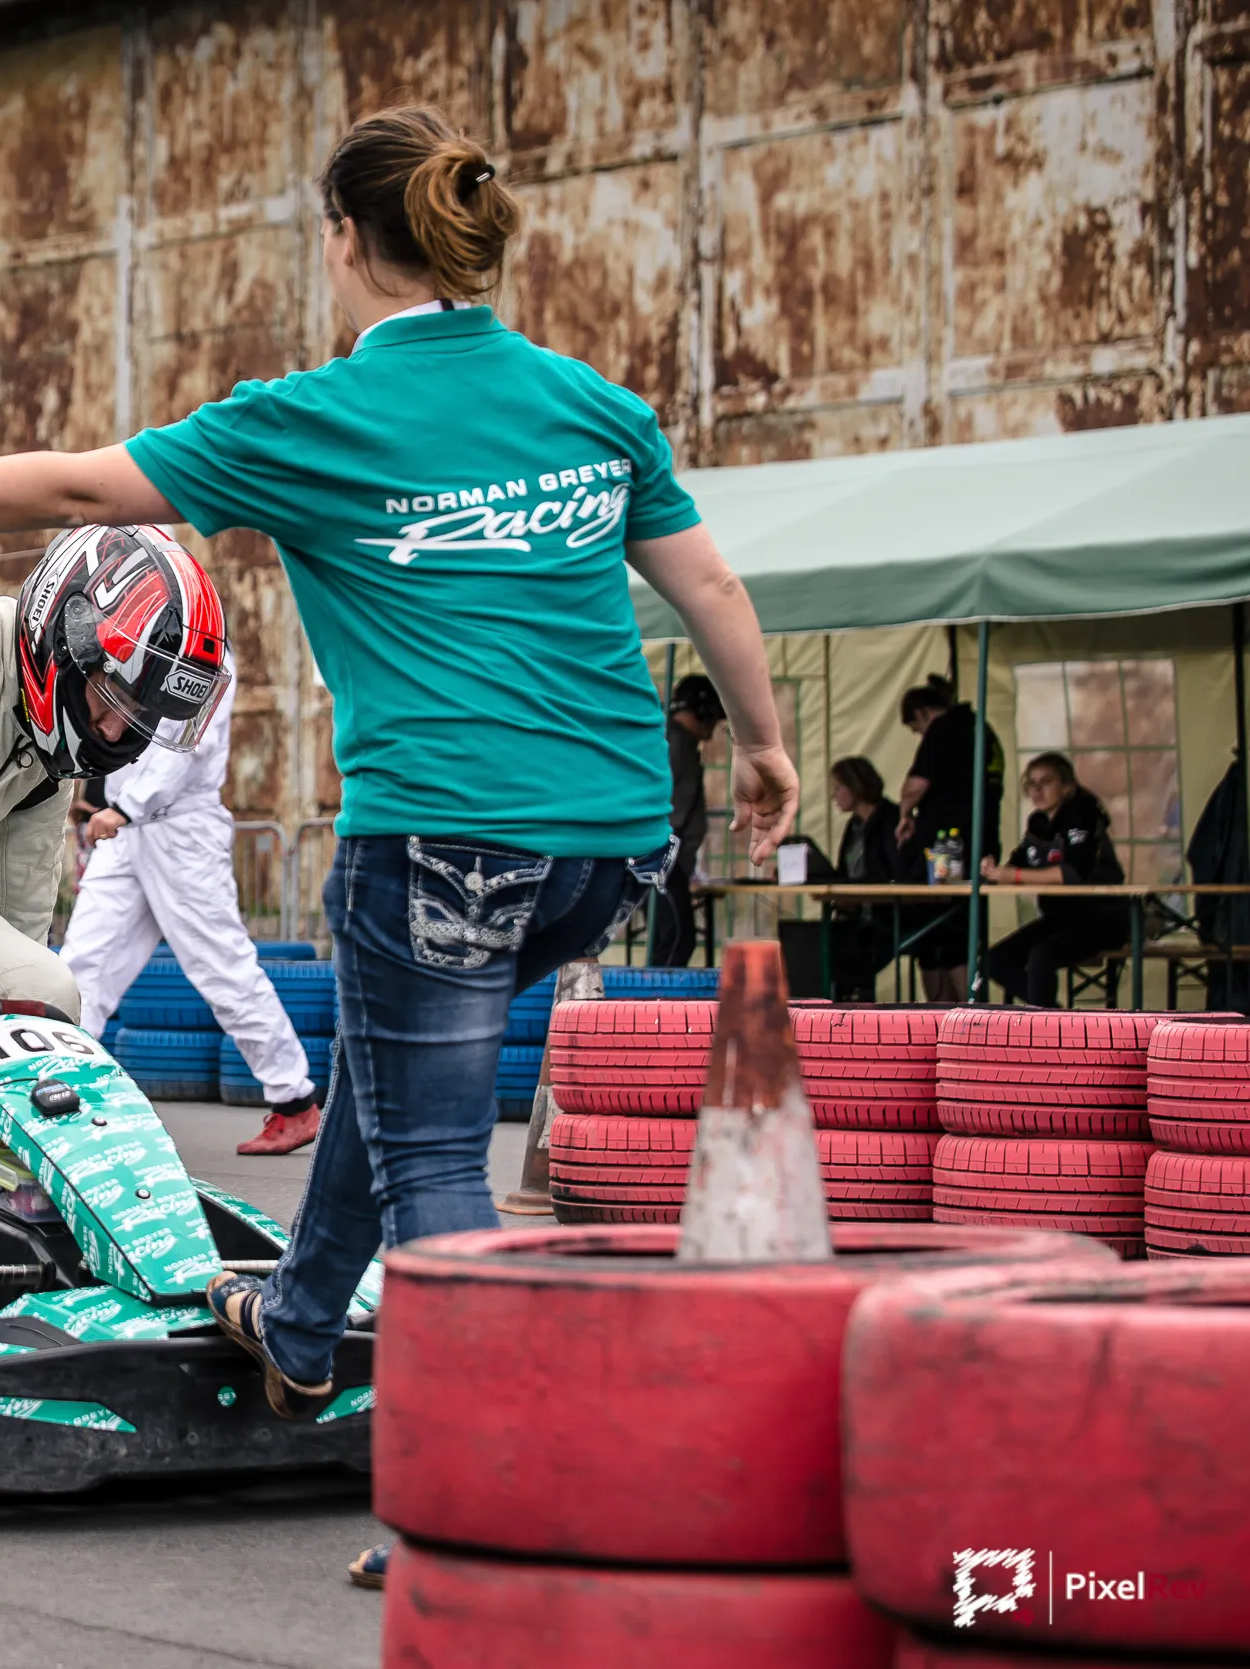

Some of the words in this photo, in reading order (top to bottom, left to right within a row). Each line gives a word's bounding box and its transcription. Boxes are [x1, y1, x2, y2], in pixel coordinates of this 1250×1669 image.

[385, 478, 528, 514] NORMAN
[537, 458, 631, 491] GREYER
[353, 483, 630, 565] Racing
[31, 580, 55, 622] SHOEI
[172, 675, 209, 699] SHOEI
[112, 1196, 199, 1232] Racing
